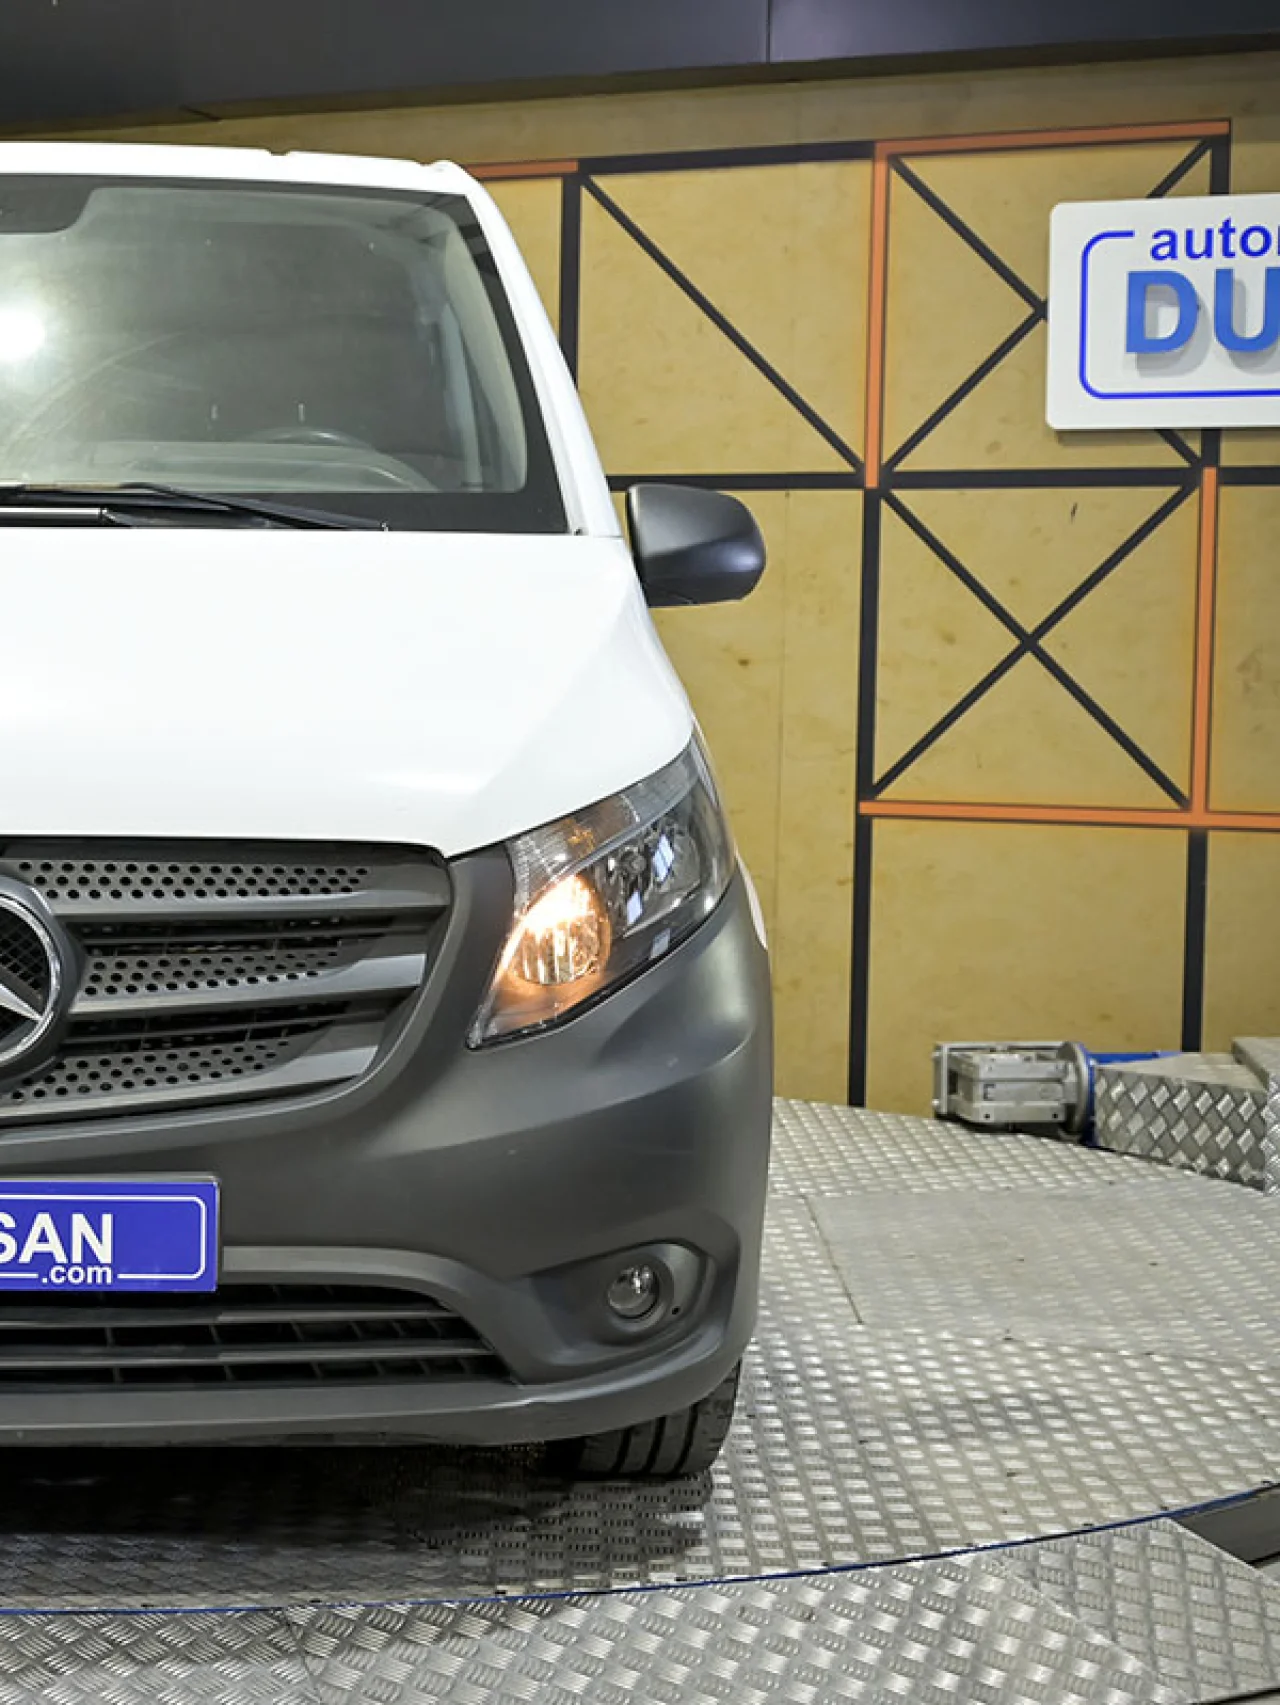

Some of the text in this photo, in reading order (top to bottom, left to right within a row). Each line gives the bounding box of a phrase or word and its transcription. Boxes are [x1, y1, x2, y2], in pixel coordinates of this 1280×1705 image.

[1149, 216, 1280, 261] auto
[1126, 266, 1280, 354] DU
[41, 1264, 113, 1285] .com
